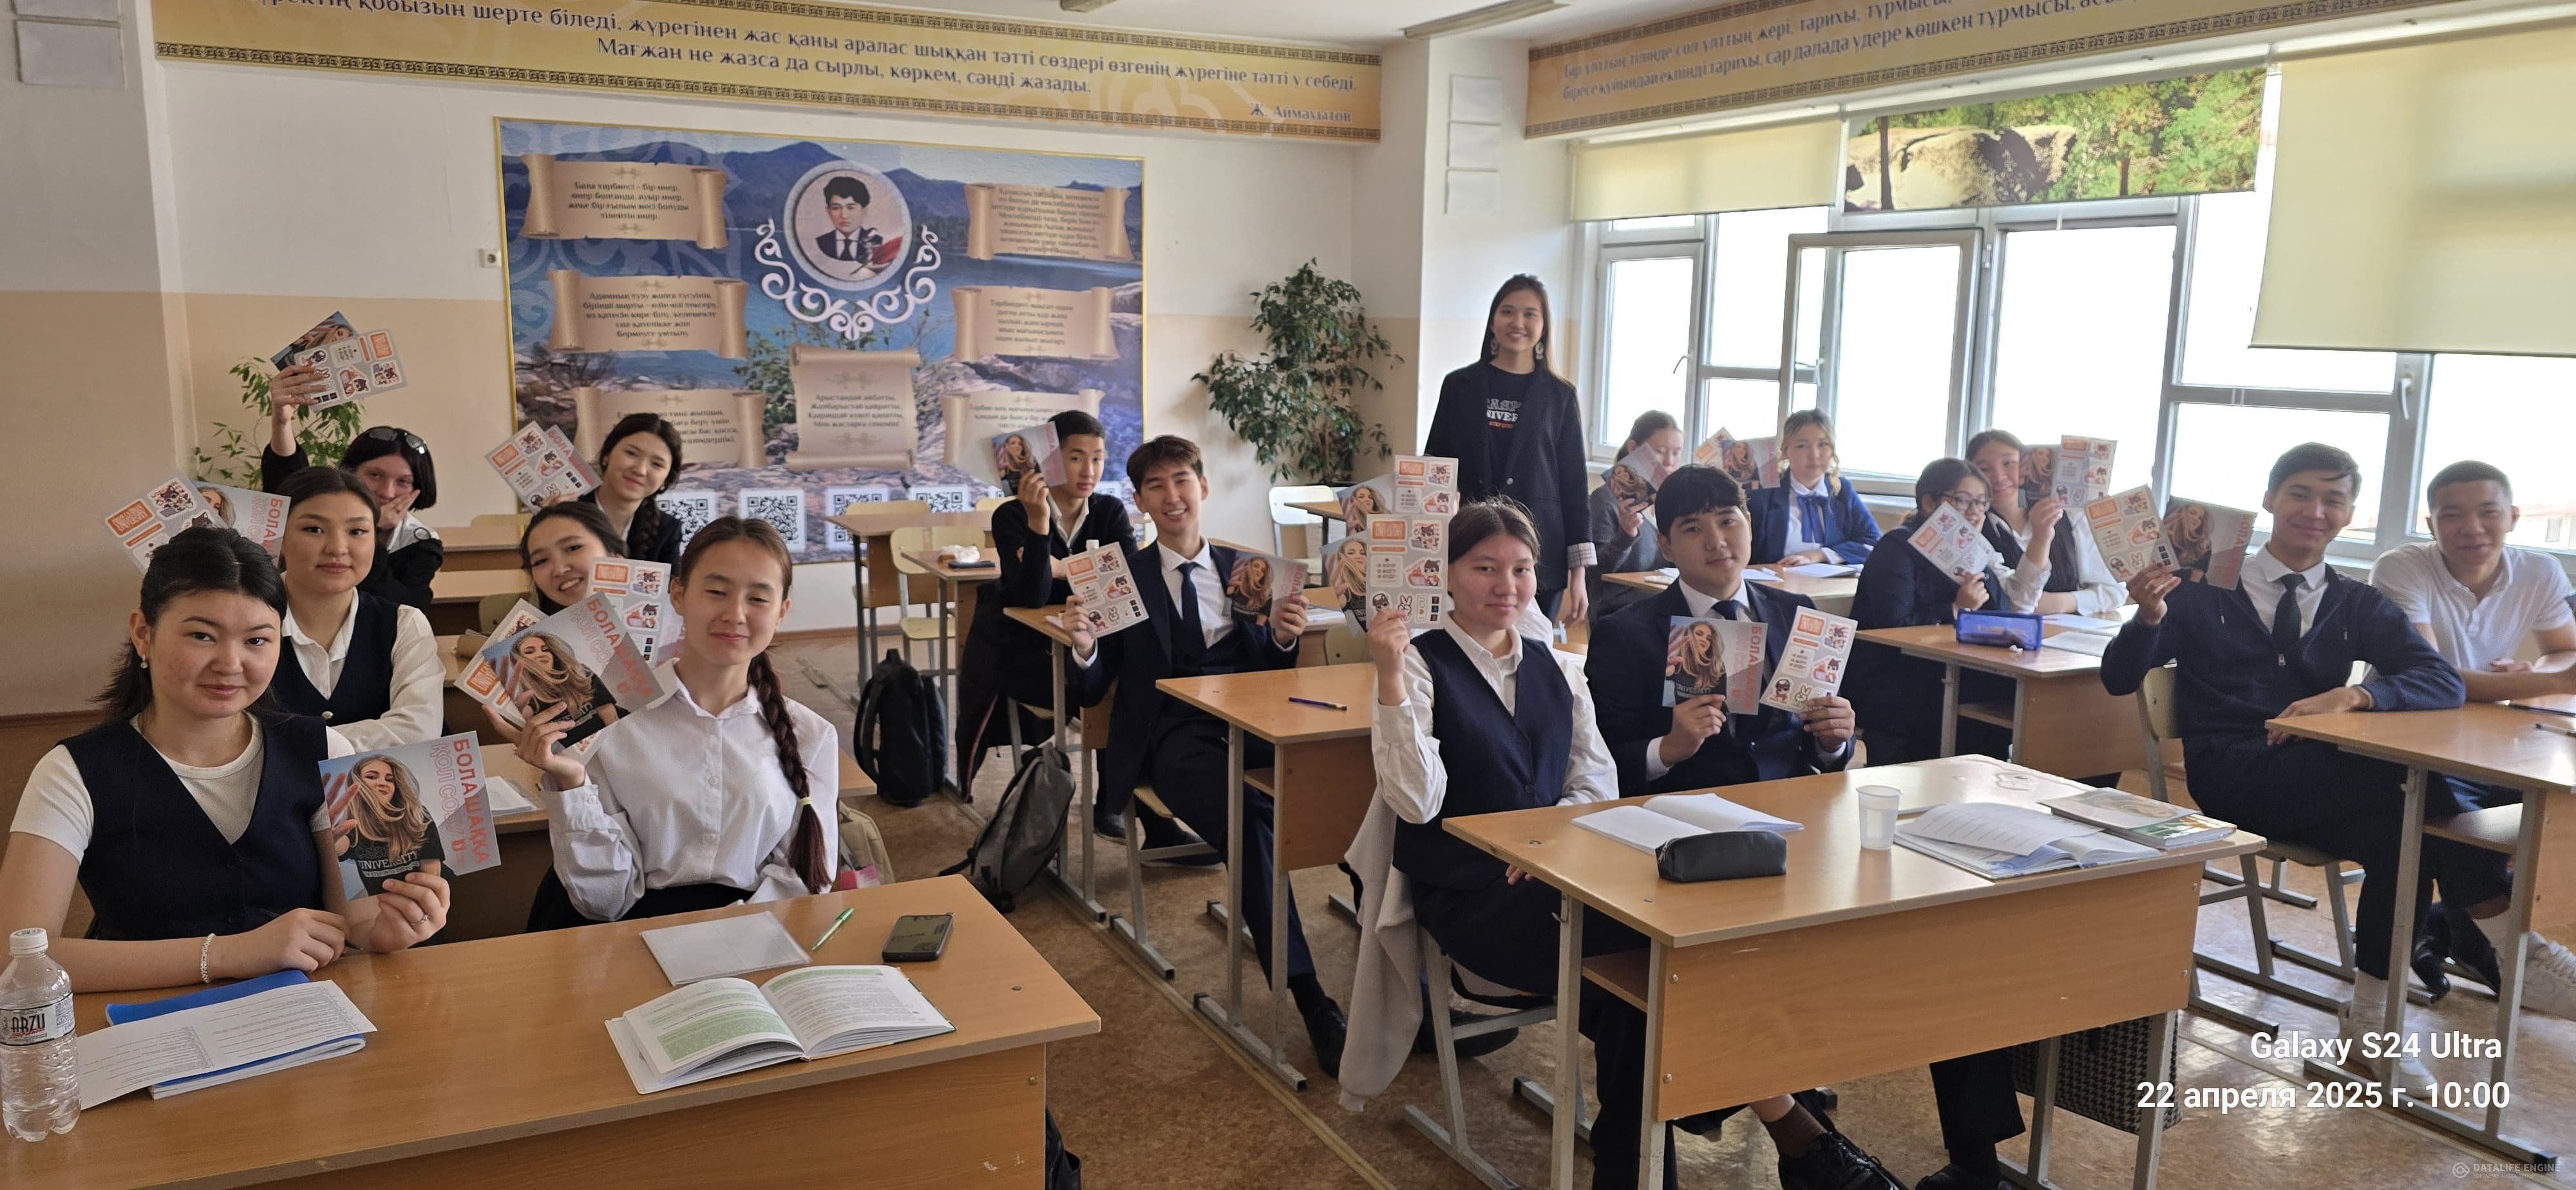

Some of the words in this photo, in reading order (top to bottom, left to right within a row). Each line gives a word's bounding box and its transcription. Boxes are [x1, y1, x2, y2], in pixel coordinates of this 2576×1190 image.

[1792, 39, 1850, 62] далада
[1905, 15, 1973, 40] көшкен
[1800, 9, 1861, 35] тарихы,
[473, 5, 543, 25] шерте
[549, 9, 622, 32] біледі,
[629, 19, 737, 39] жүрегінен
[744, 28, 780, 44] жас
[788, 33, 838, 50] қаны
[845, 38, 909, 55] аралас
[914, 42, 987, 62] шыққан
[992, 50, 1034, 66] тәтті
[1039, 53, 1104, 73] сөздері
[1108, 59, 1170, 77] өзгенің
[1175, 64, 1247, 82] жүрегіне
[1251, 71, 1289, 85] тәтті
[1305, 74, 1357, 91] себеді.
[598, 37, 682, 60] Мағжан
[688, 47, 714, 62] не
[719, 51, 779, 68] жазса
[785, 55, 809, 73] да
[815, 60, 884, 79] сырлы,
[889, 68, 962, 85] көркем,
[967, 71, 1015, 88] сәнді
[1021, 75, 1091, 93] жазады.
[1250, 102, 1269, 118] Ж.
[430, 742, 456, 783] ҚОЛ
[11, 1013, 45, 1033] ARZU
